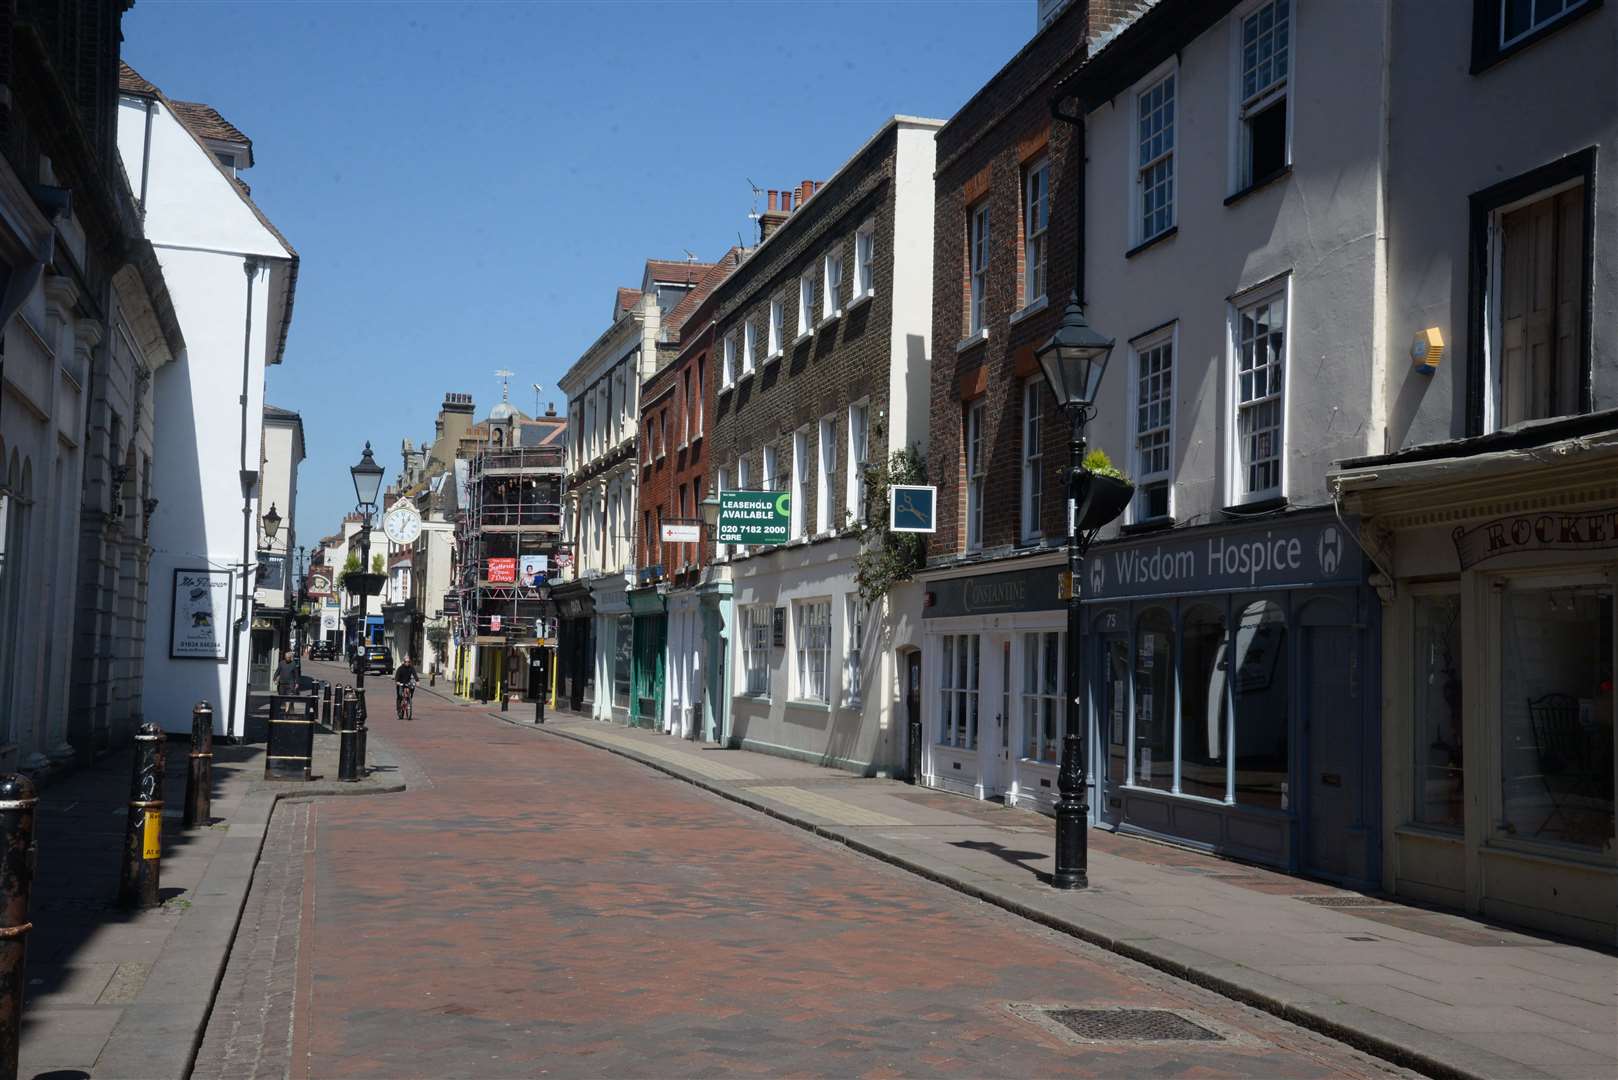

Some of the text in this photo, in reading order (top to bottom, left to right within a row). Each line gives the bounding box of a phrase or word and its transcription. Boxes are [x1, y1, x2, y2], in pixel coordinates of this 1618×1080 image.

[722, 501, 773, 510] LEASEHOLD
[722, 510, 774, 519] AVAILABLE
[721, 525, 738, 533] 020
[763, 526, 786, 534] 2000
[1115, 531, 1301, 585] Wisdom Hospice
[1106, 614, 1116, 628] 75
